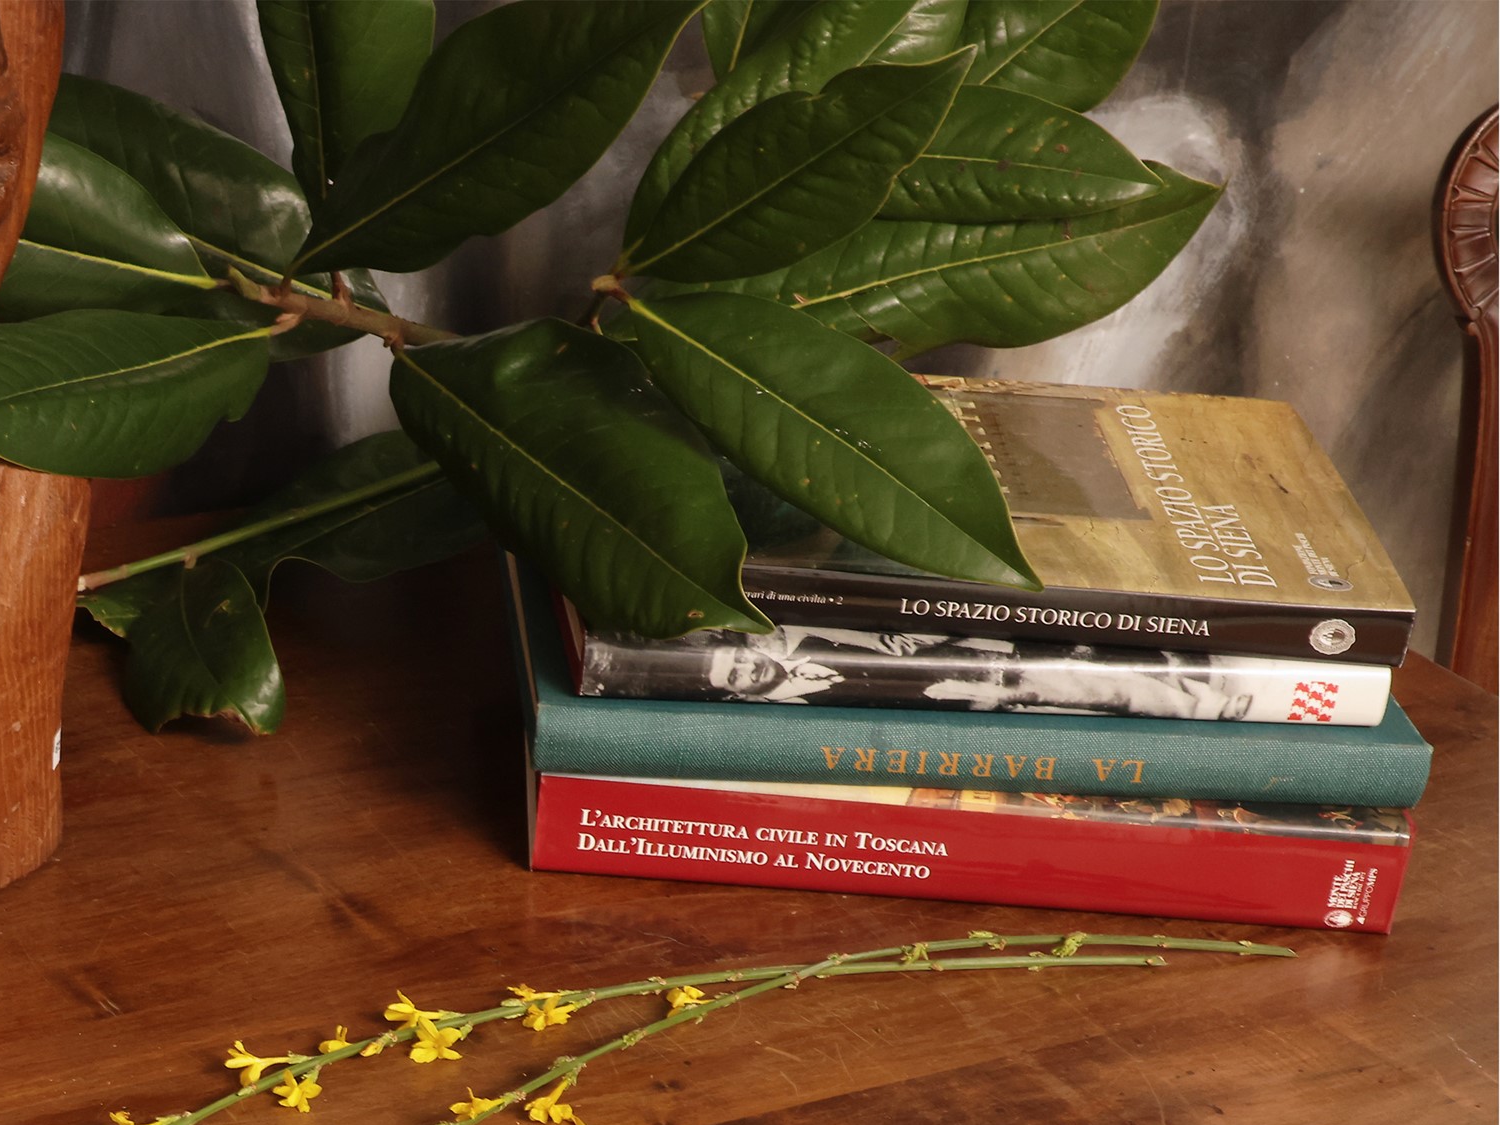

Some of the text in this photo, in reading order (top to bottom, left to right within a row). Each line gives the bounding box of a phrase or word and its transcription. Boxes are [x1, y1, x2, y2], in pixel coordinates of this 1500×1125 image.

[1116, 405, 1237, 585] LO SPAZIO STORICO
[1201, 504, 1278, 588] DI SIENA
[766, 590, 776, 600] di
[778, 593, 795, 602] una
[835, 596, 844, 605] 2
[900, 598, 1211, 637] LO SPAZIO STORICO DI SIENA
[821, 746, 1145, 784] LA BARRIERA
[755, 826, 819, 847] CIVILE
[824, 832, 848, 849] IN
[854, 831, 949, 858] TOSCANA
[773, 853, 799, 869] AL
[805, 853, 931, 880] NOVECENTO
